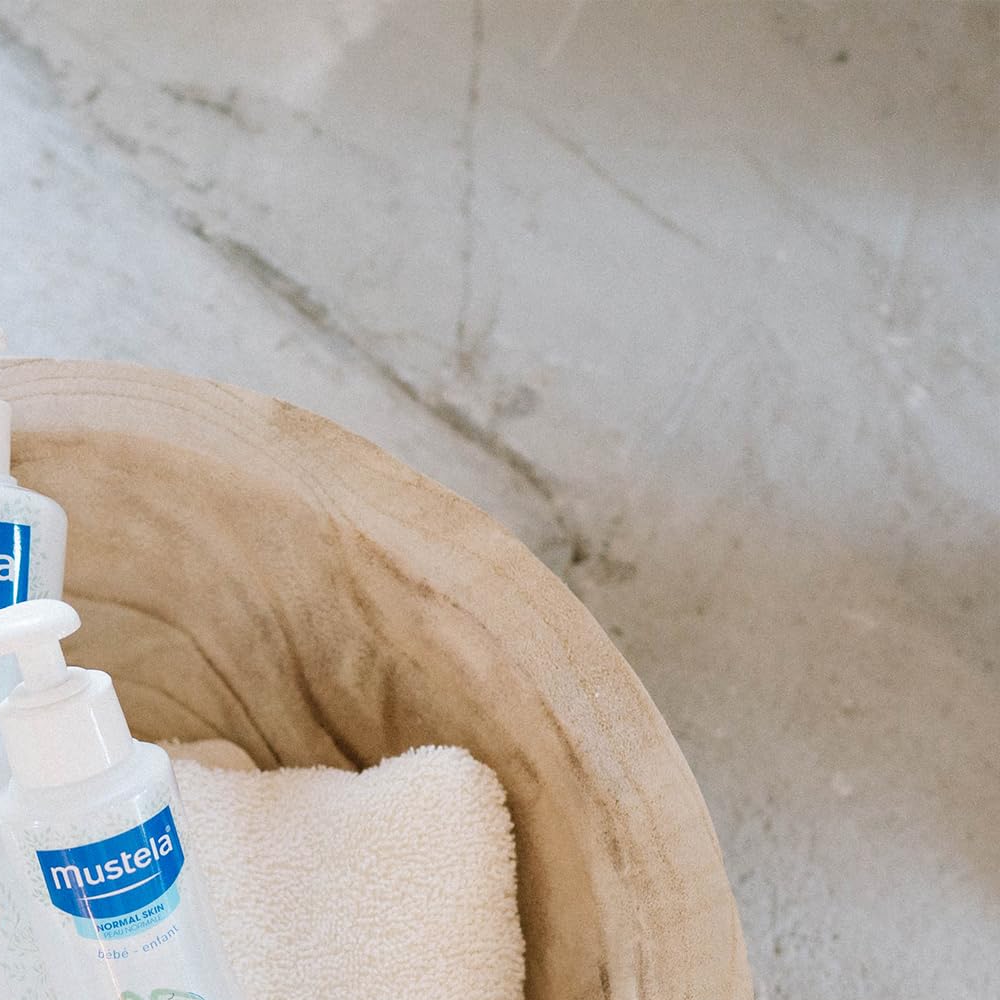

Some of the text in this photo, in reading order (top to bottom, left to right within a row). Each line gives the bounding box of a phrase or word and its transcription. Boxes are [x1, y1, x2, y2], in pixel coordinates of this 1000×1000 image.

[97, 903, 165, 932] NORMAL SKIN
[142, 925, 179, 953] enfant
